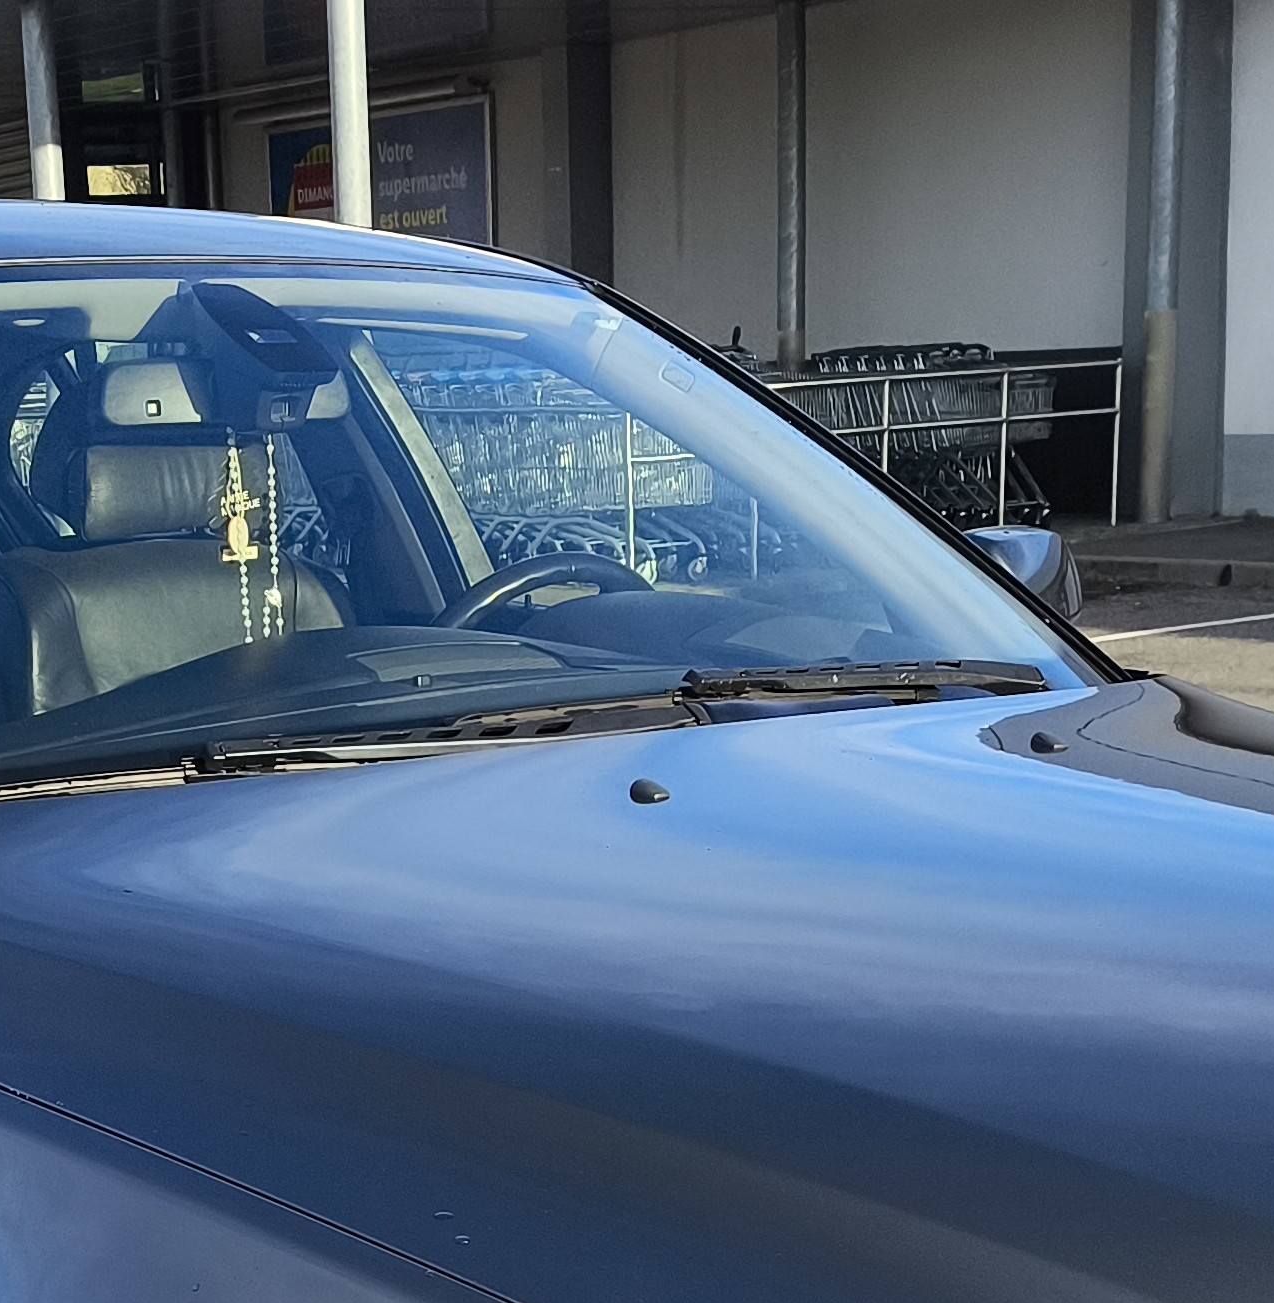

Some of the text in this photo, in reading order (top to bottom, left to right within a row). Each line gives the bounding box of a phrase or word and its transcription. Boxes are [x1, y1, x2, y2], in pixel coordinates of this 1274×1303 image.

[378, 142, 414, 163] Votre
[297, 187, 334, 204] DIMANC
[379, 167, 468, 201] supermarché
[380, 205, 448, 230] est ouvert
